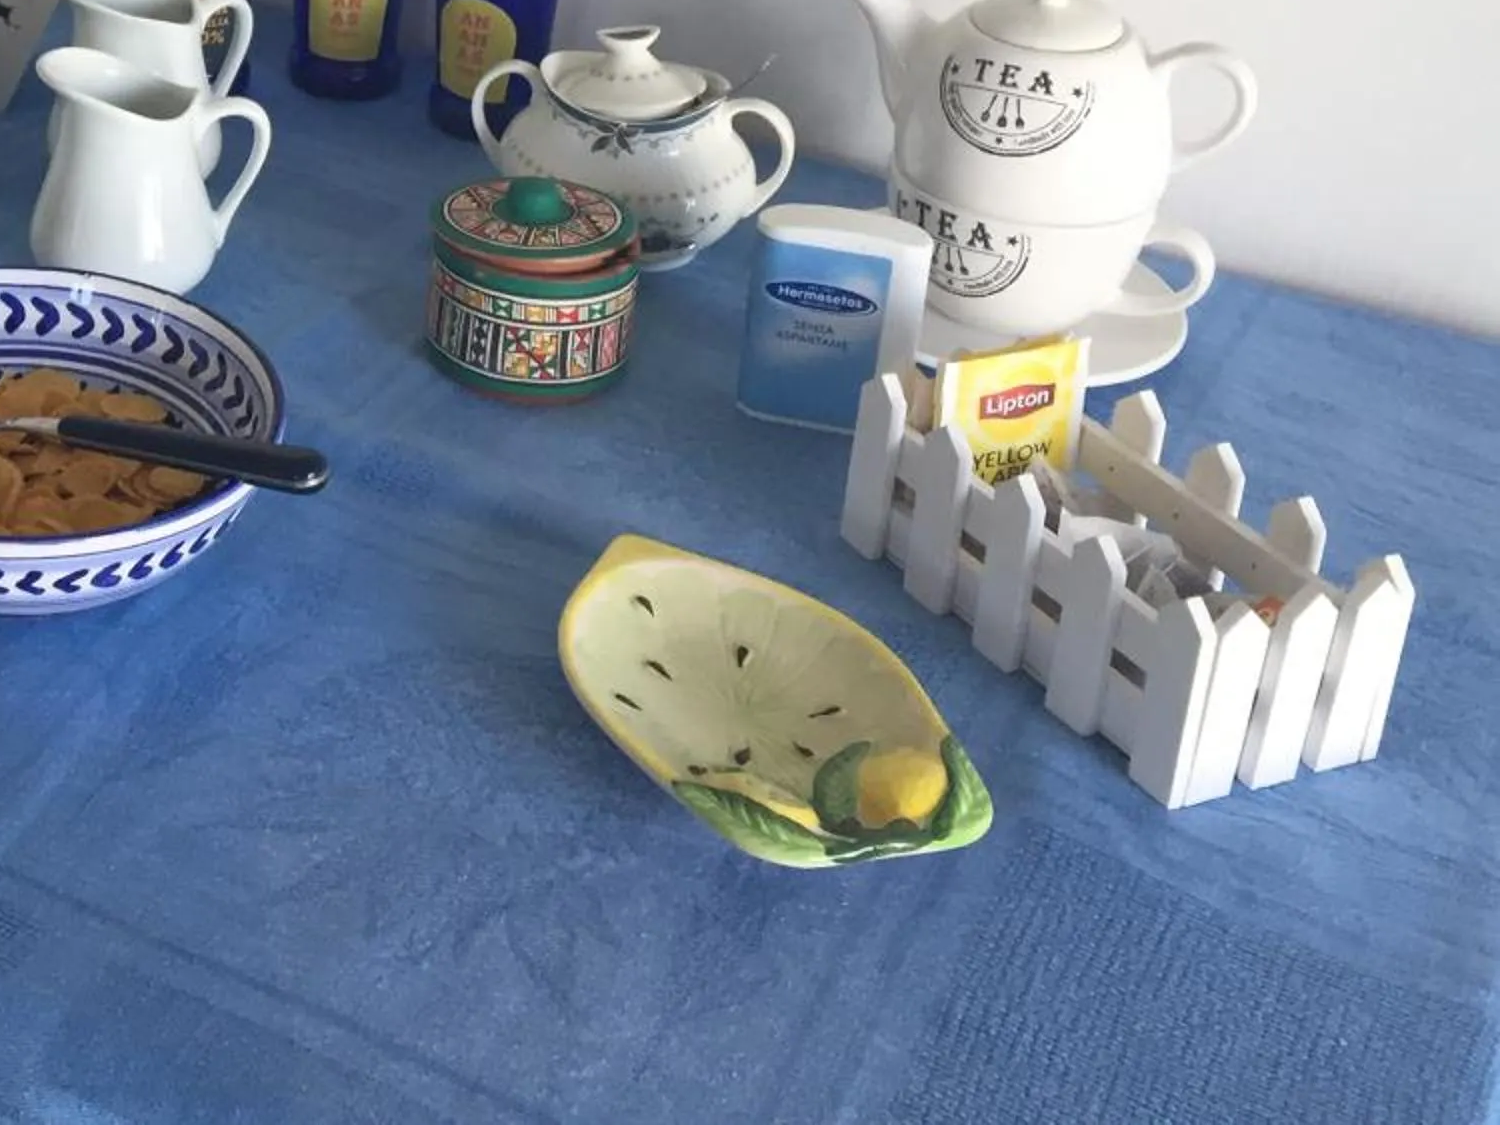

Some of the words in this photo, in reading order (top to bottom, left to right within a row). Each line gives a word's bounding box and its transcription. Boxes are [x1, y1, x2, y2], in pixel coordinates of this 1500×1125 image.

[974, 57, 1055, 96] TEA
[914, 198, 995, 252] TEA
[985, 389, 1050, 416] Lipton
[973, 439, 1053, 471] YELLOW
